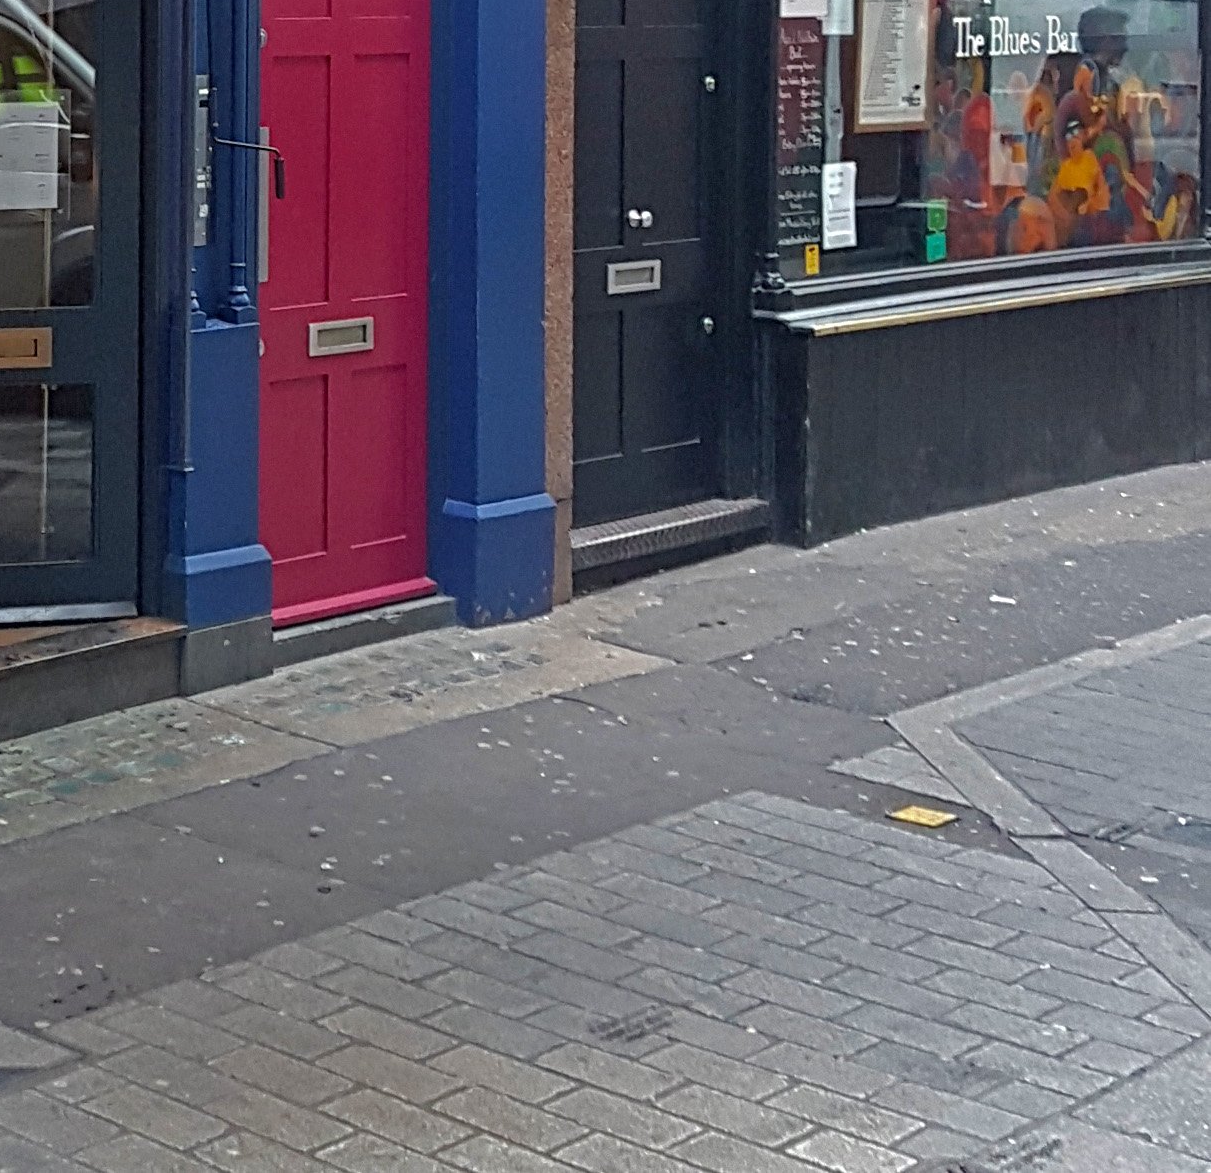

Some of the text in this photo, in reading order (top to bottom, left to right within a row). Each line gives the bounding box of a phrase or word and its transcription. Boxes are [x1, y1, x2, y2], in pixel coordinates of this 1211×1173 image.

[953, 15, 1079, 57] The Blues Bar
